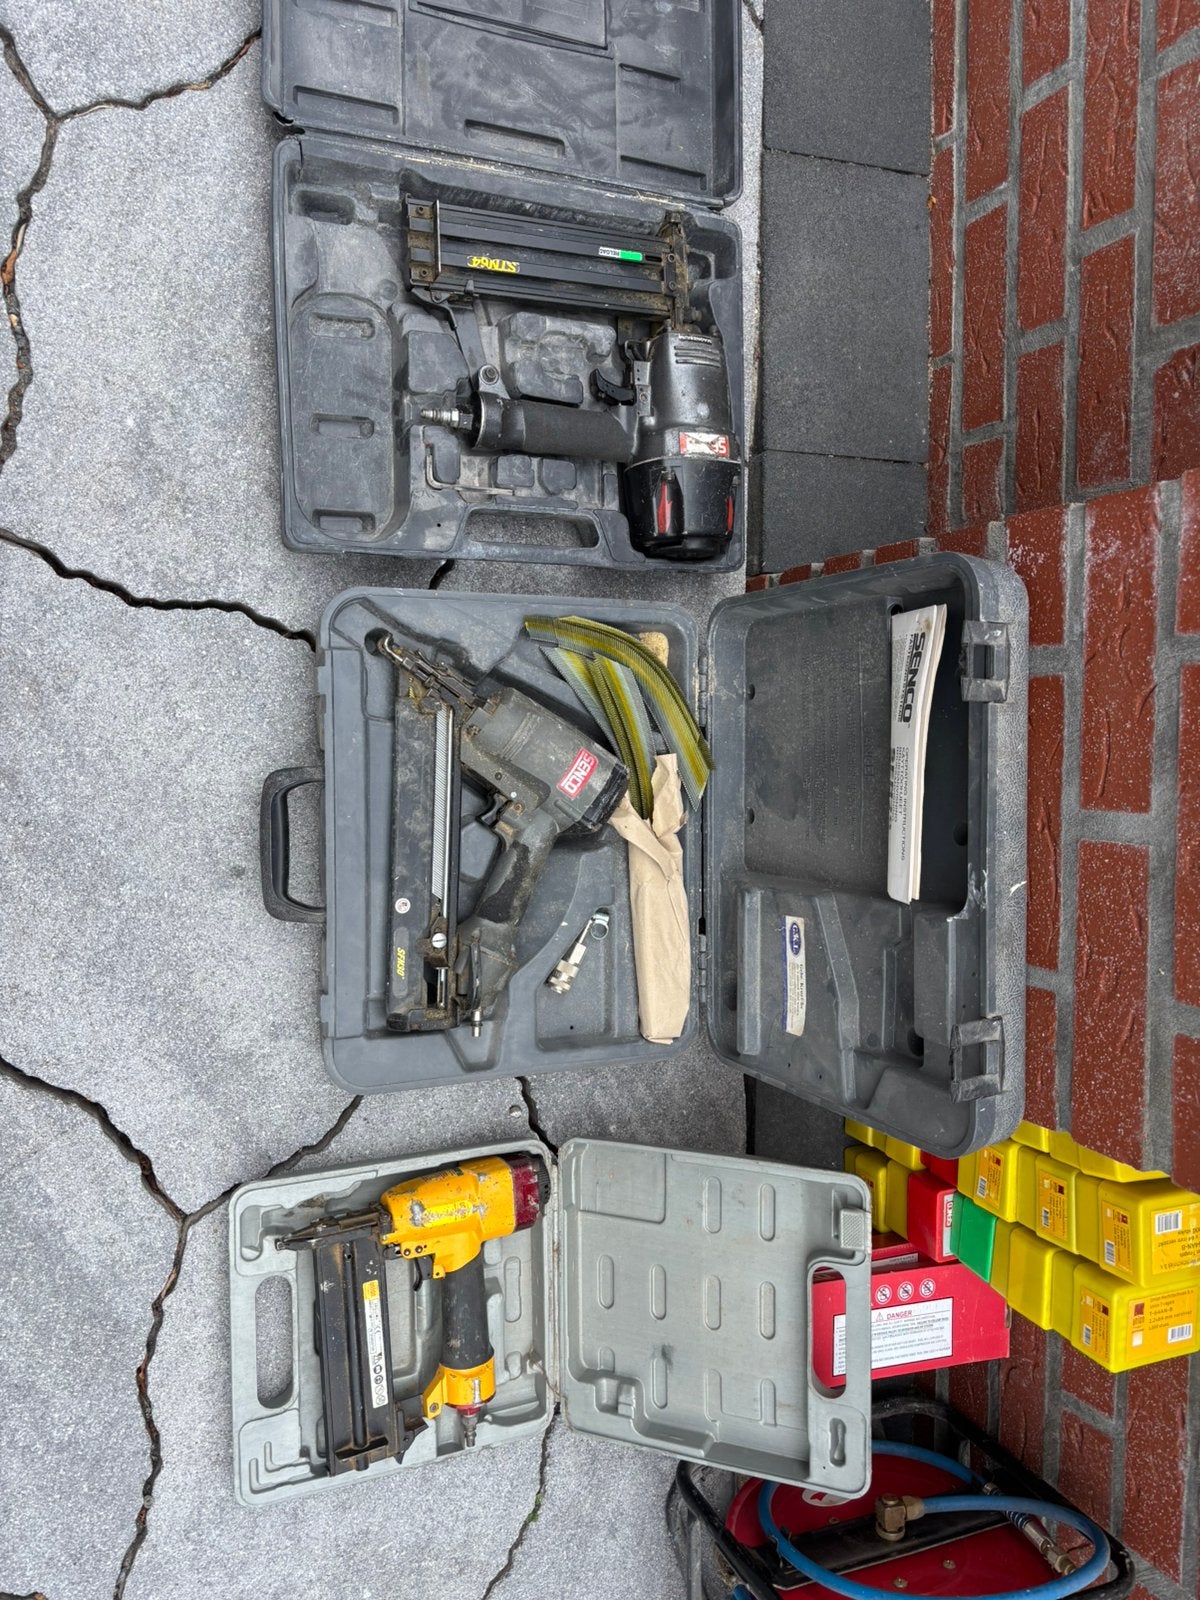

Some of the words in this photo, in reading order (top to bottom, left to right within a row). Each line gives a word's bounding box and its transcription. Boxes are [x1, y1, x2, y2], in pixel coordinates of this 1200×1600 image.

[902, 632, 925, 723] SENCO
[564, 752, 594, 794] SENCO
[886, 1310, 913, 1320] DANGER
